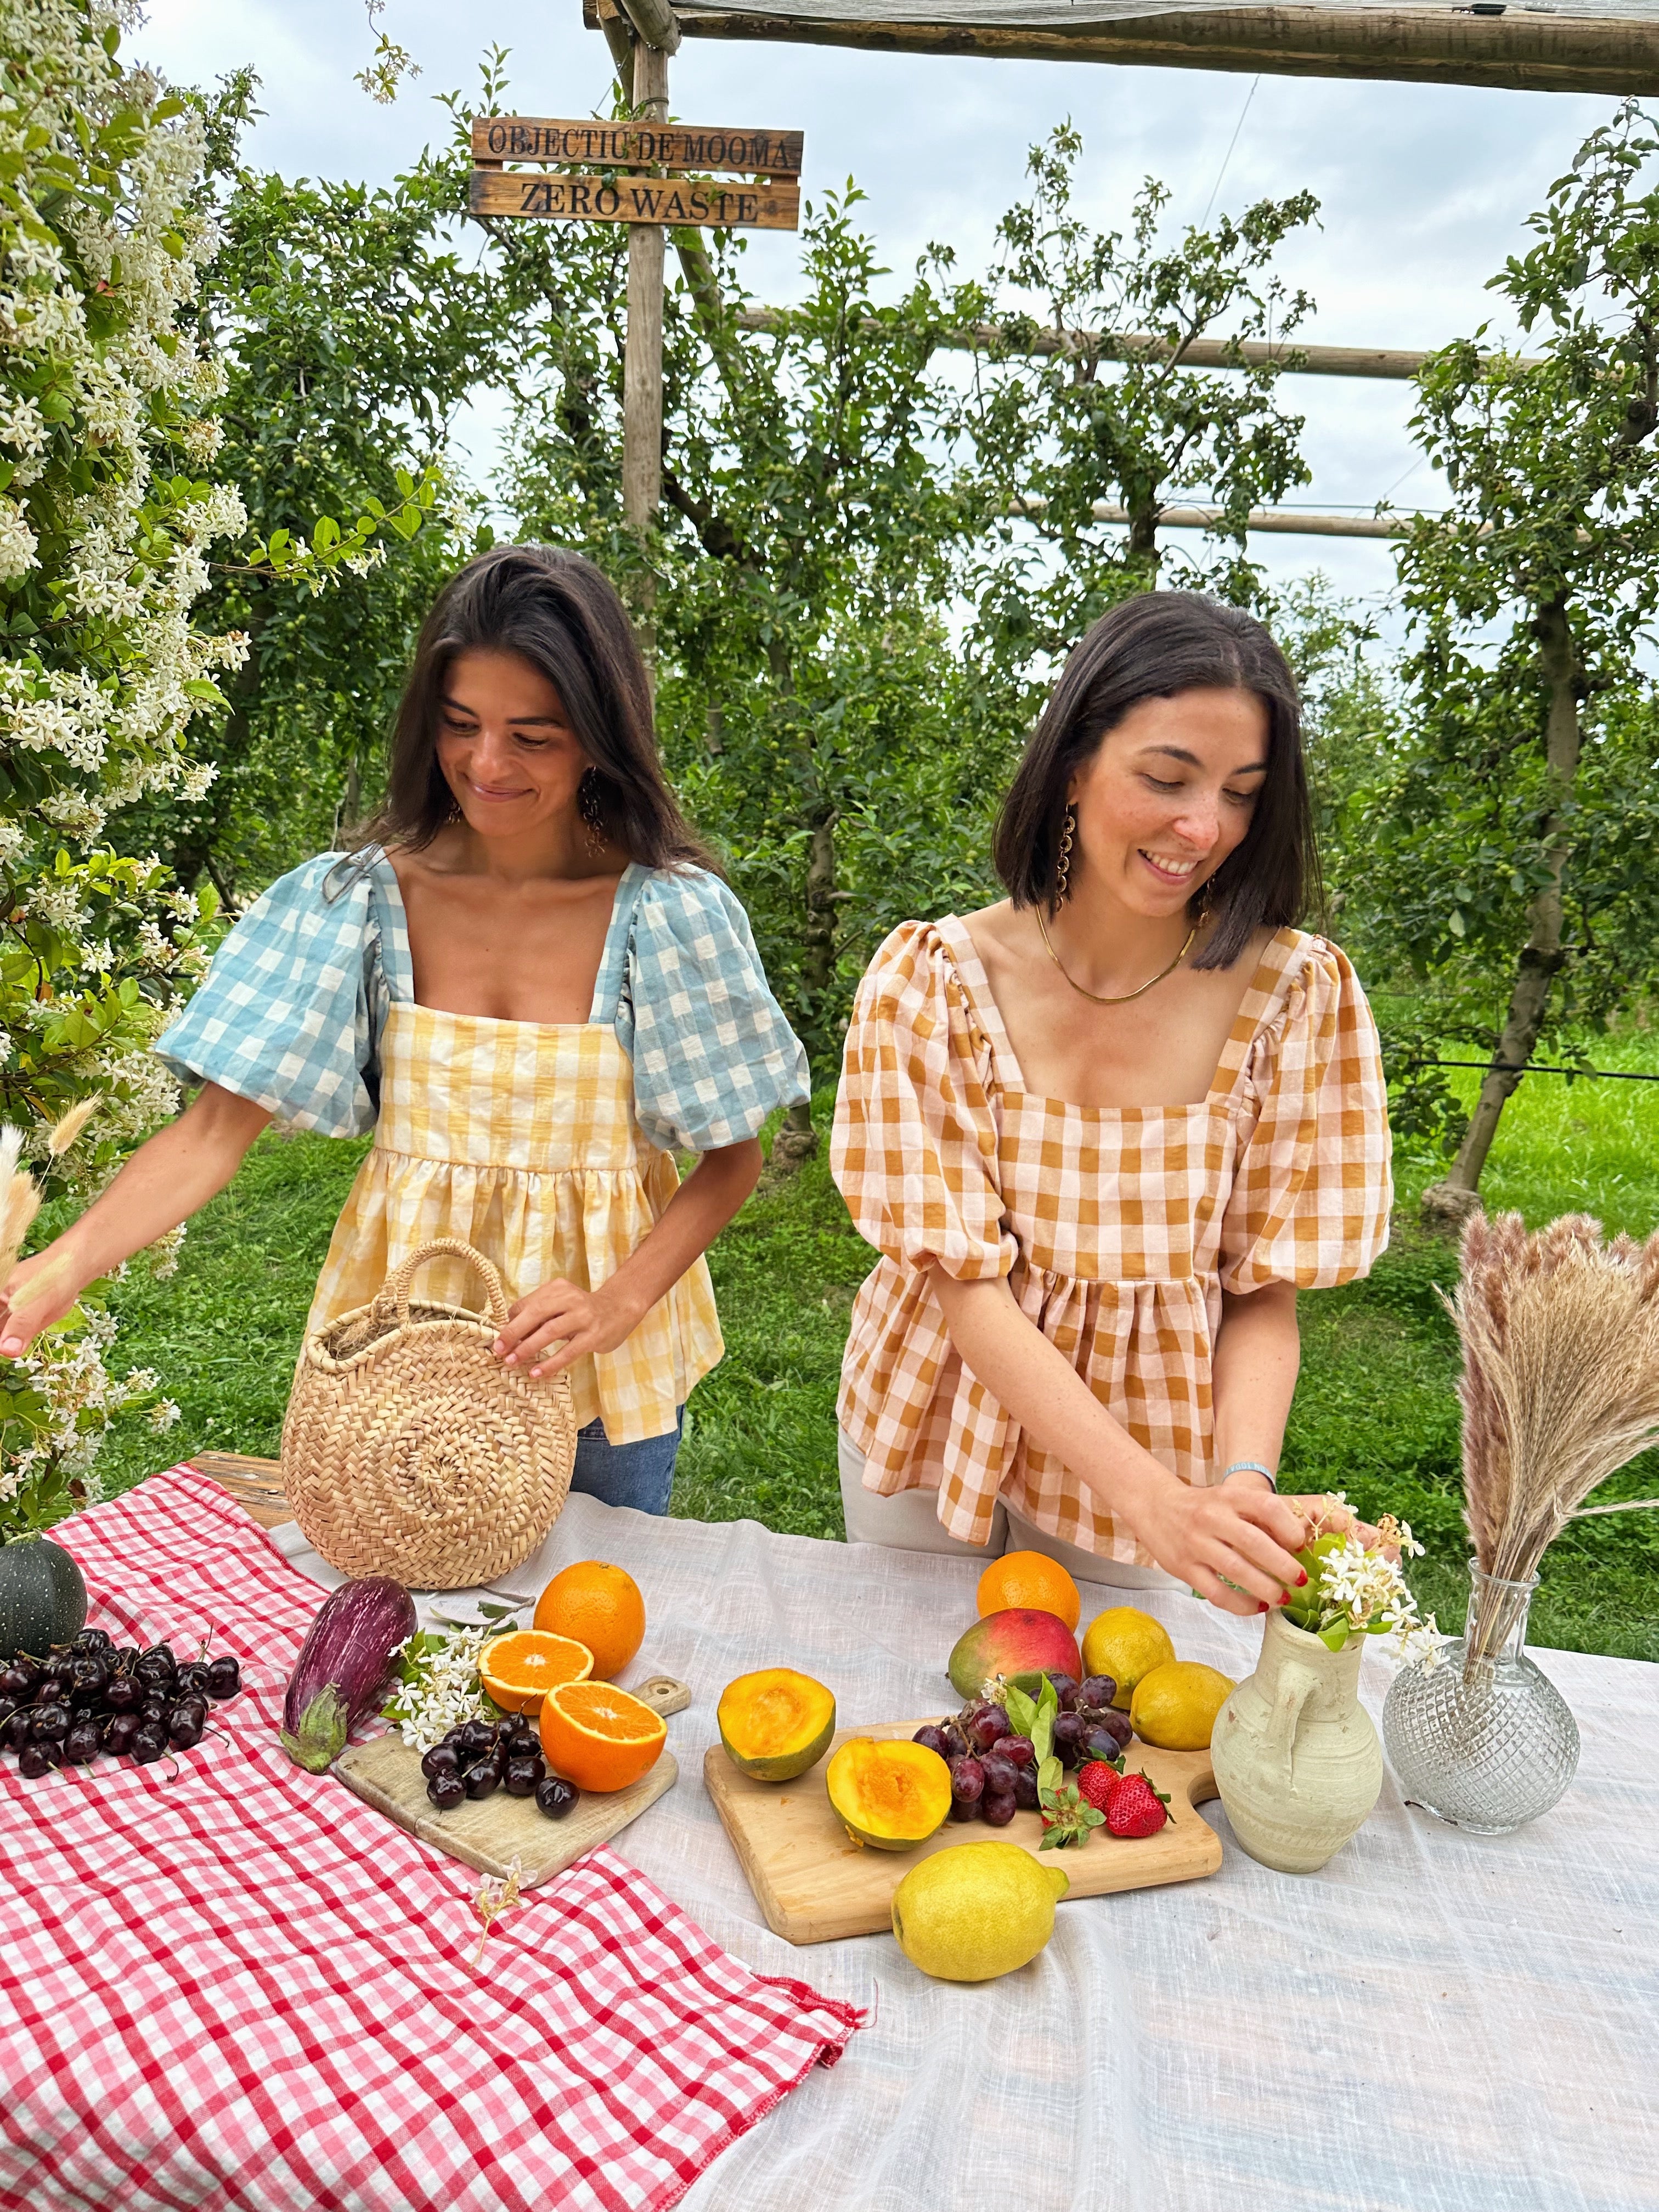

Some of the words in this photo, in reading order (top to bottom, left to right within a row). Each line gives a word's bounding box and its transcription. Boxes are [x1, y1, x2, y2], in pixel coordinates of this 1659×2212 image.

[488, 125, 629, 159] OBJECTIU
[637, 132, 674, 160] DE
[682, 134, 789, 168] MOOMA
[520, 183, 620, 216] ZERO
[630, 188, 758, 222] WASTE
